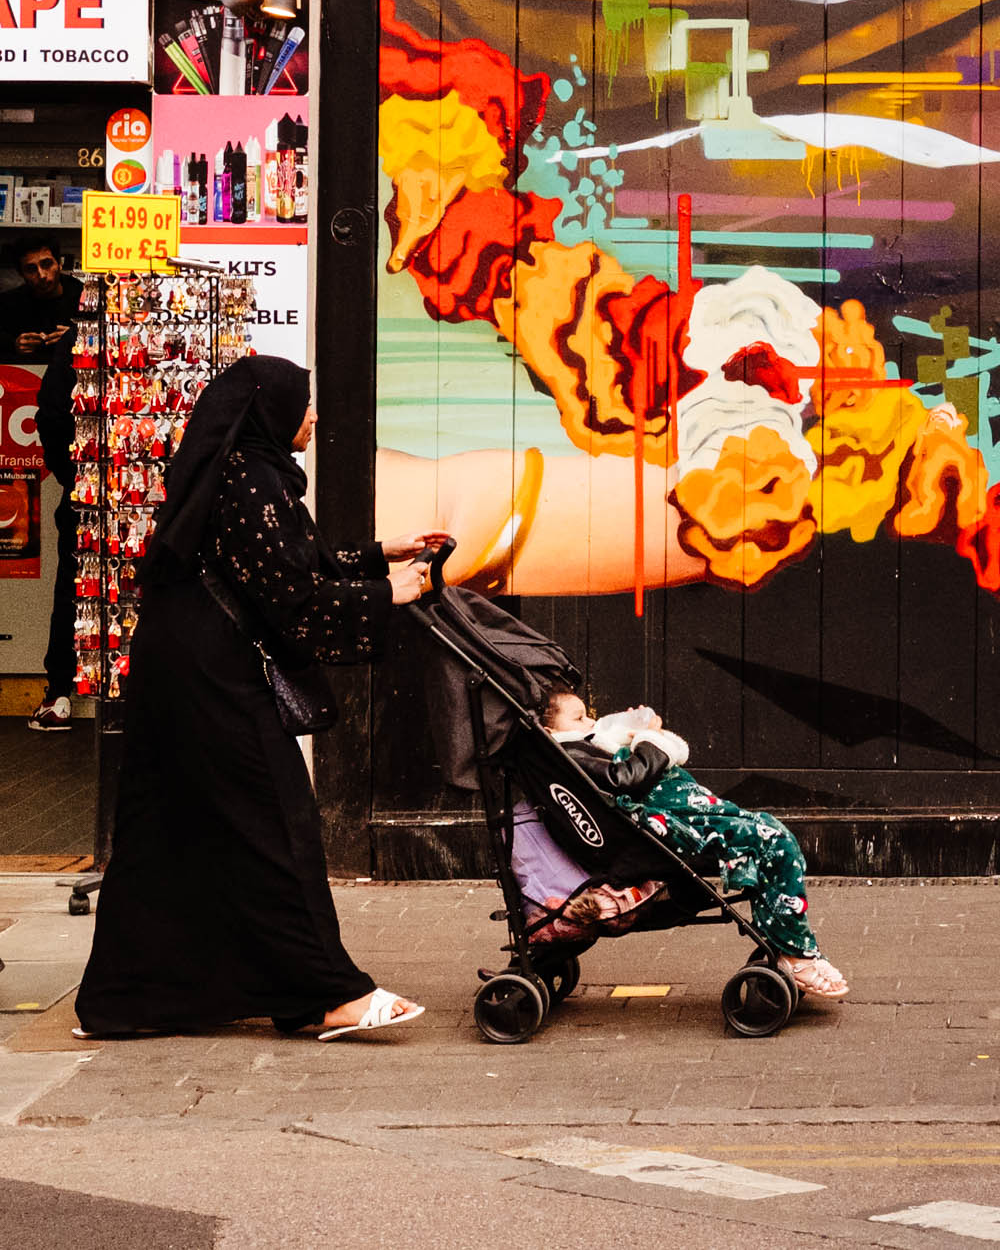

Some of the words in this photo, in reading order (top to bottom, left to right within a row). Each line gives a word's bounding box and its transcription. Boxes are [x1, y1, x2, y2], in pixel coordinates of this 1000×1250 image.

[0, 49, 16, 63] D
[39, 49, 130, 63] TOBACCO
[112, 113, 147, 137] ria
[77, 148, 104, 168] 86
[92, 206, 148, 229] £1.99
[153, 213, 172, 231] or
[92, 242, 102, 259] 3
[107, 242, 132, 260] for
[138, 238, 168, 260] £5
[228, 260, 278, 277] KITS
[0, 454, 44, 467] Transfe
[557, 792, 600, 842] GRACO
